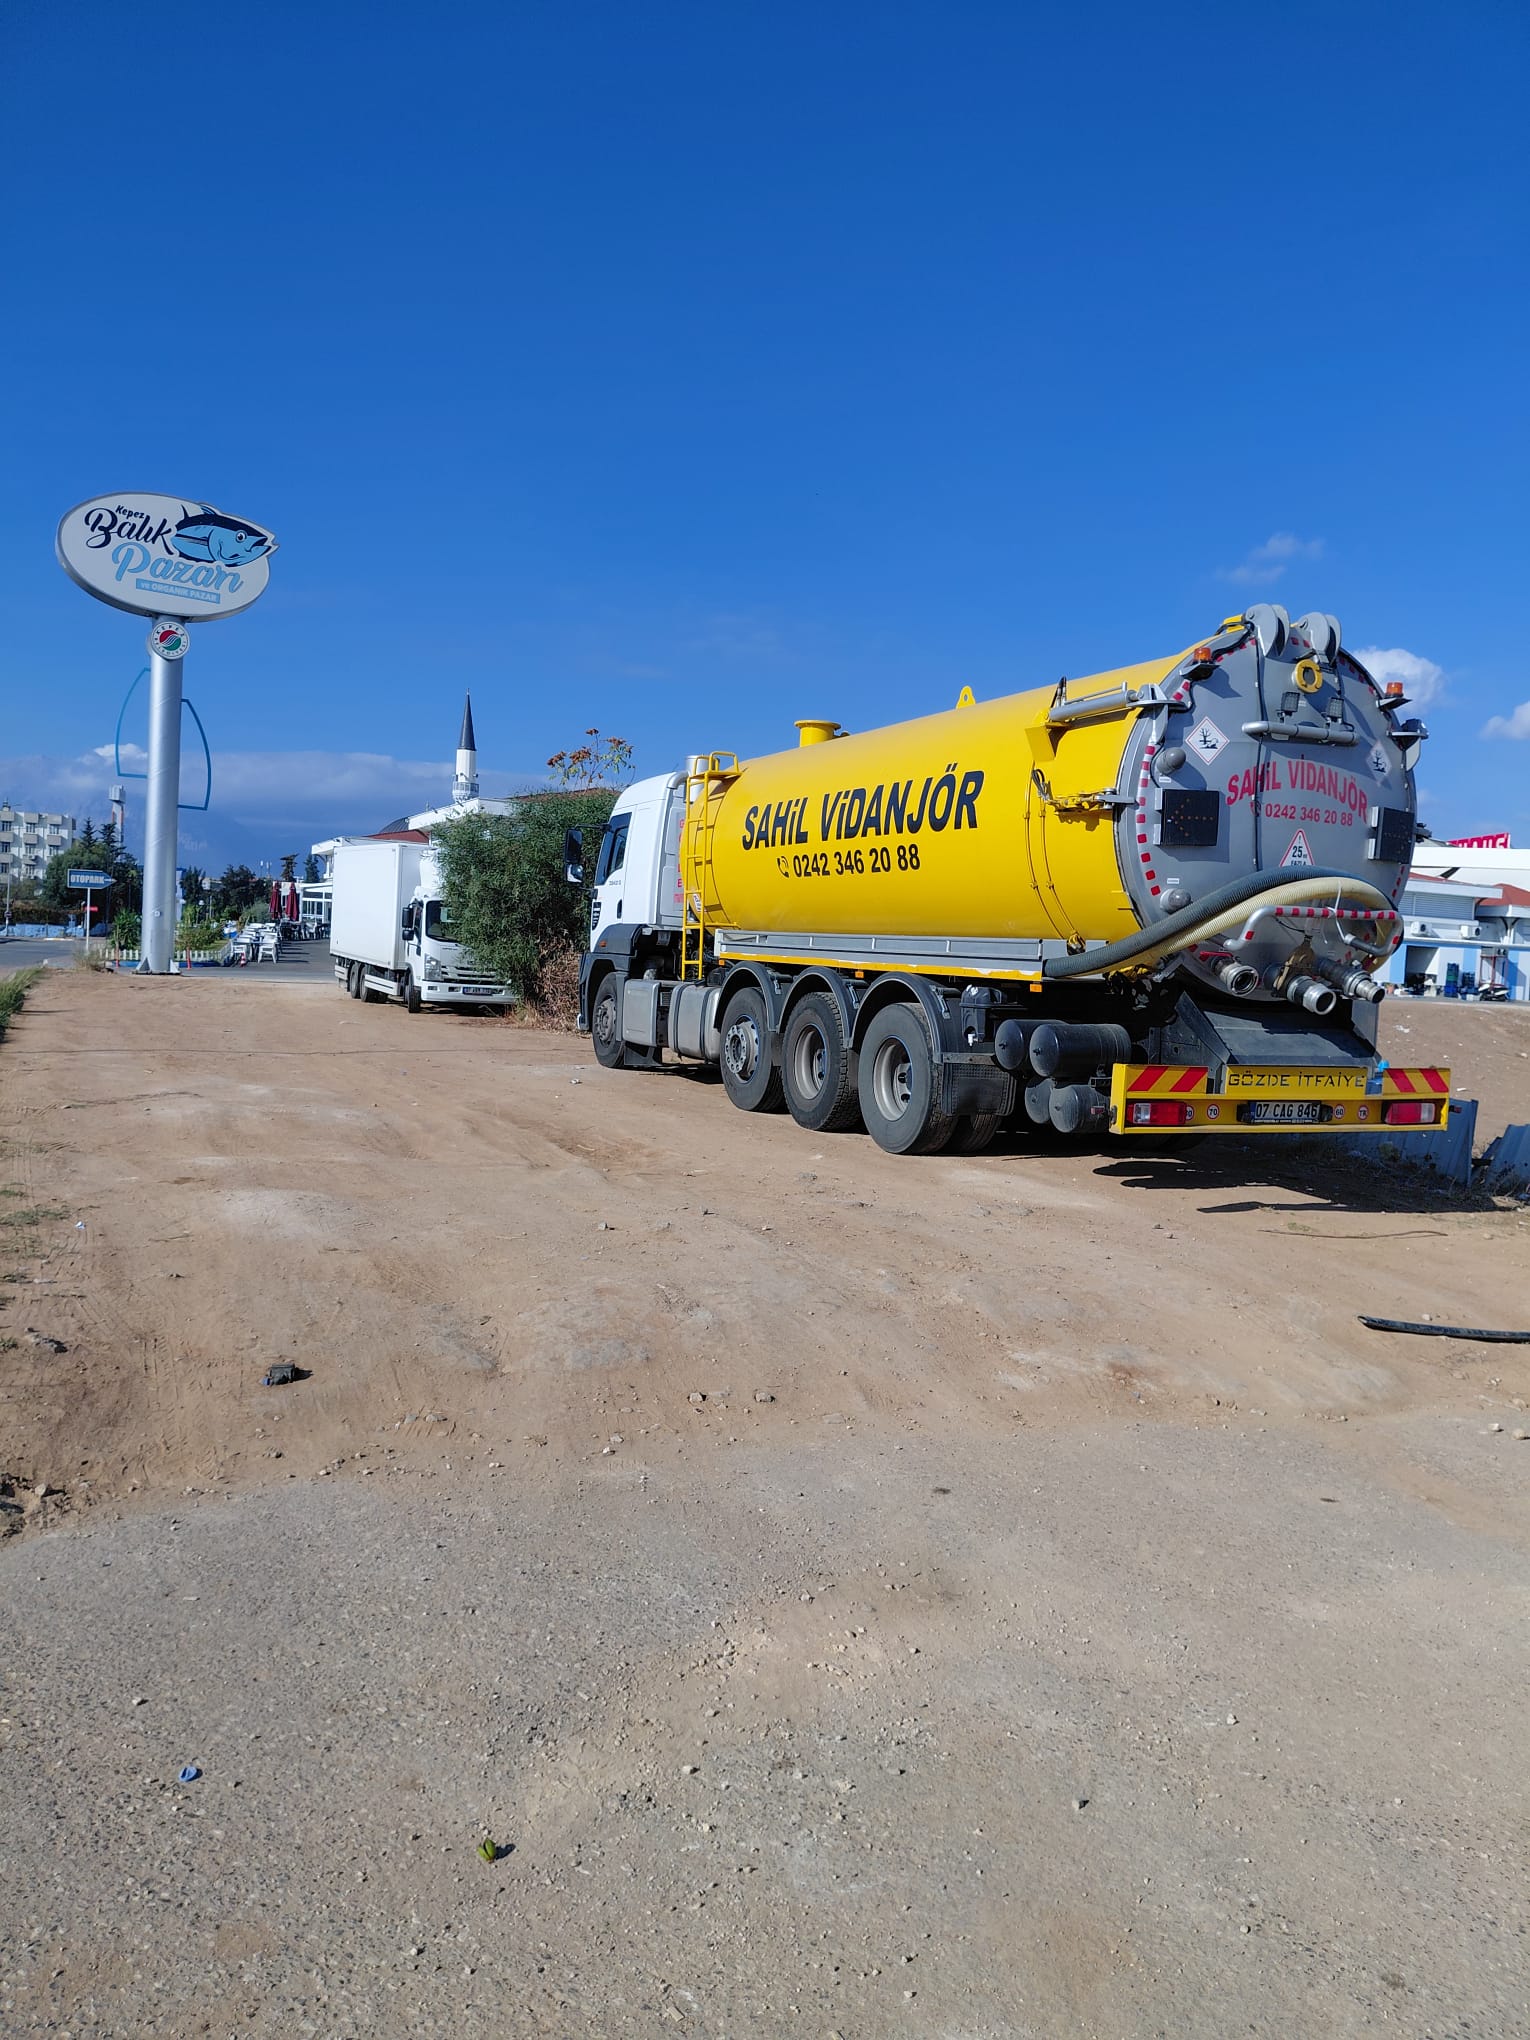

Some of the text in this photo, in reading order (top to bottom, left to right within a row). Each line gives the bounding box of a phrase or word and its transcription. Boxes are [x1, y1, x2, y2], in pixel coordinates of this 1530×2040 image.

[115, 505, 145, 519] Kepez
[84, 508, 174, 555] Balık
[1265, 803, 1353, 826] 0242 346 20 88
[1292, 845, 1304, 858] 25
[793, 843, 921, 878] 0242 346 20 88
[70, 874, 105, 884] OTOPARK
[1228, 1070, 1291, 1087] GÖZDE
[1209, 1108, 1218, 1116] 70
[1255, 1103, 1318, 1118] 07 CAG 846
